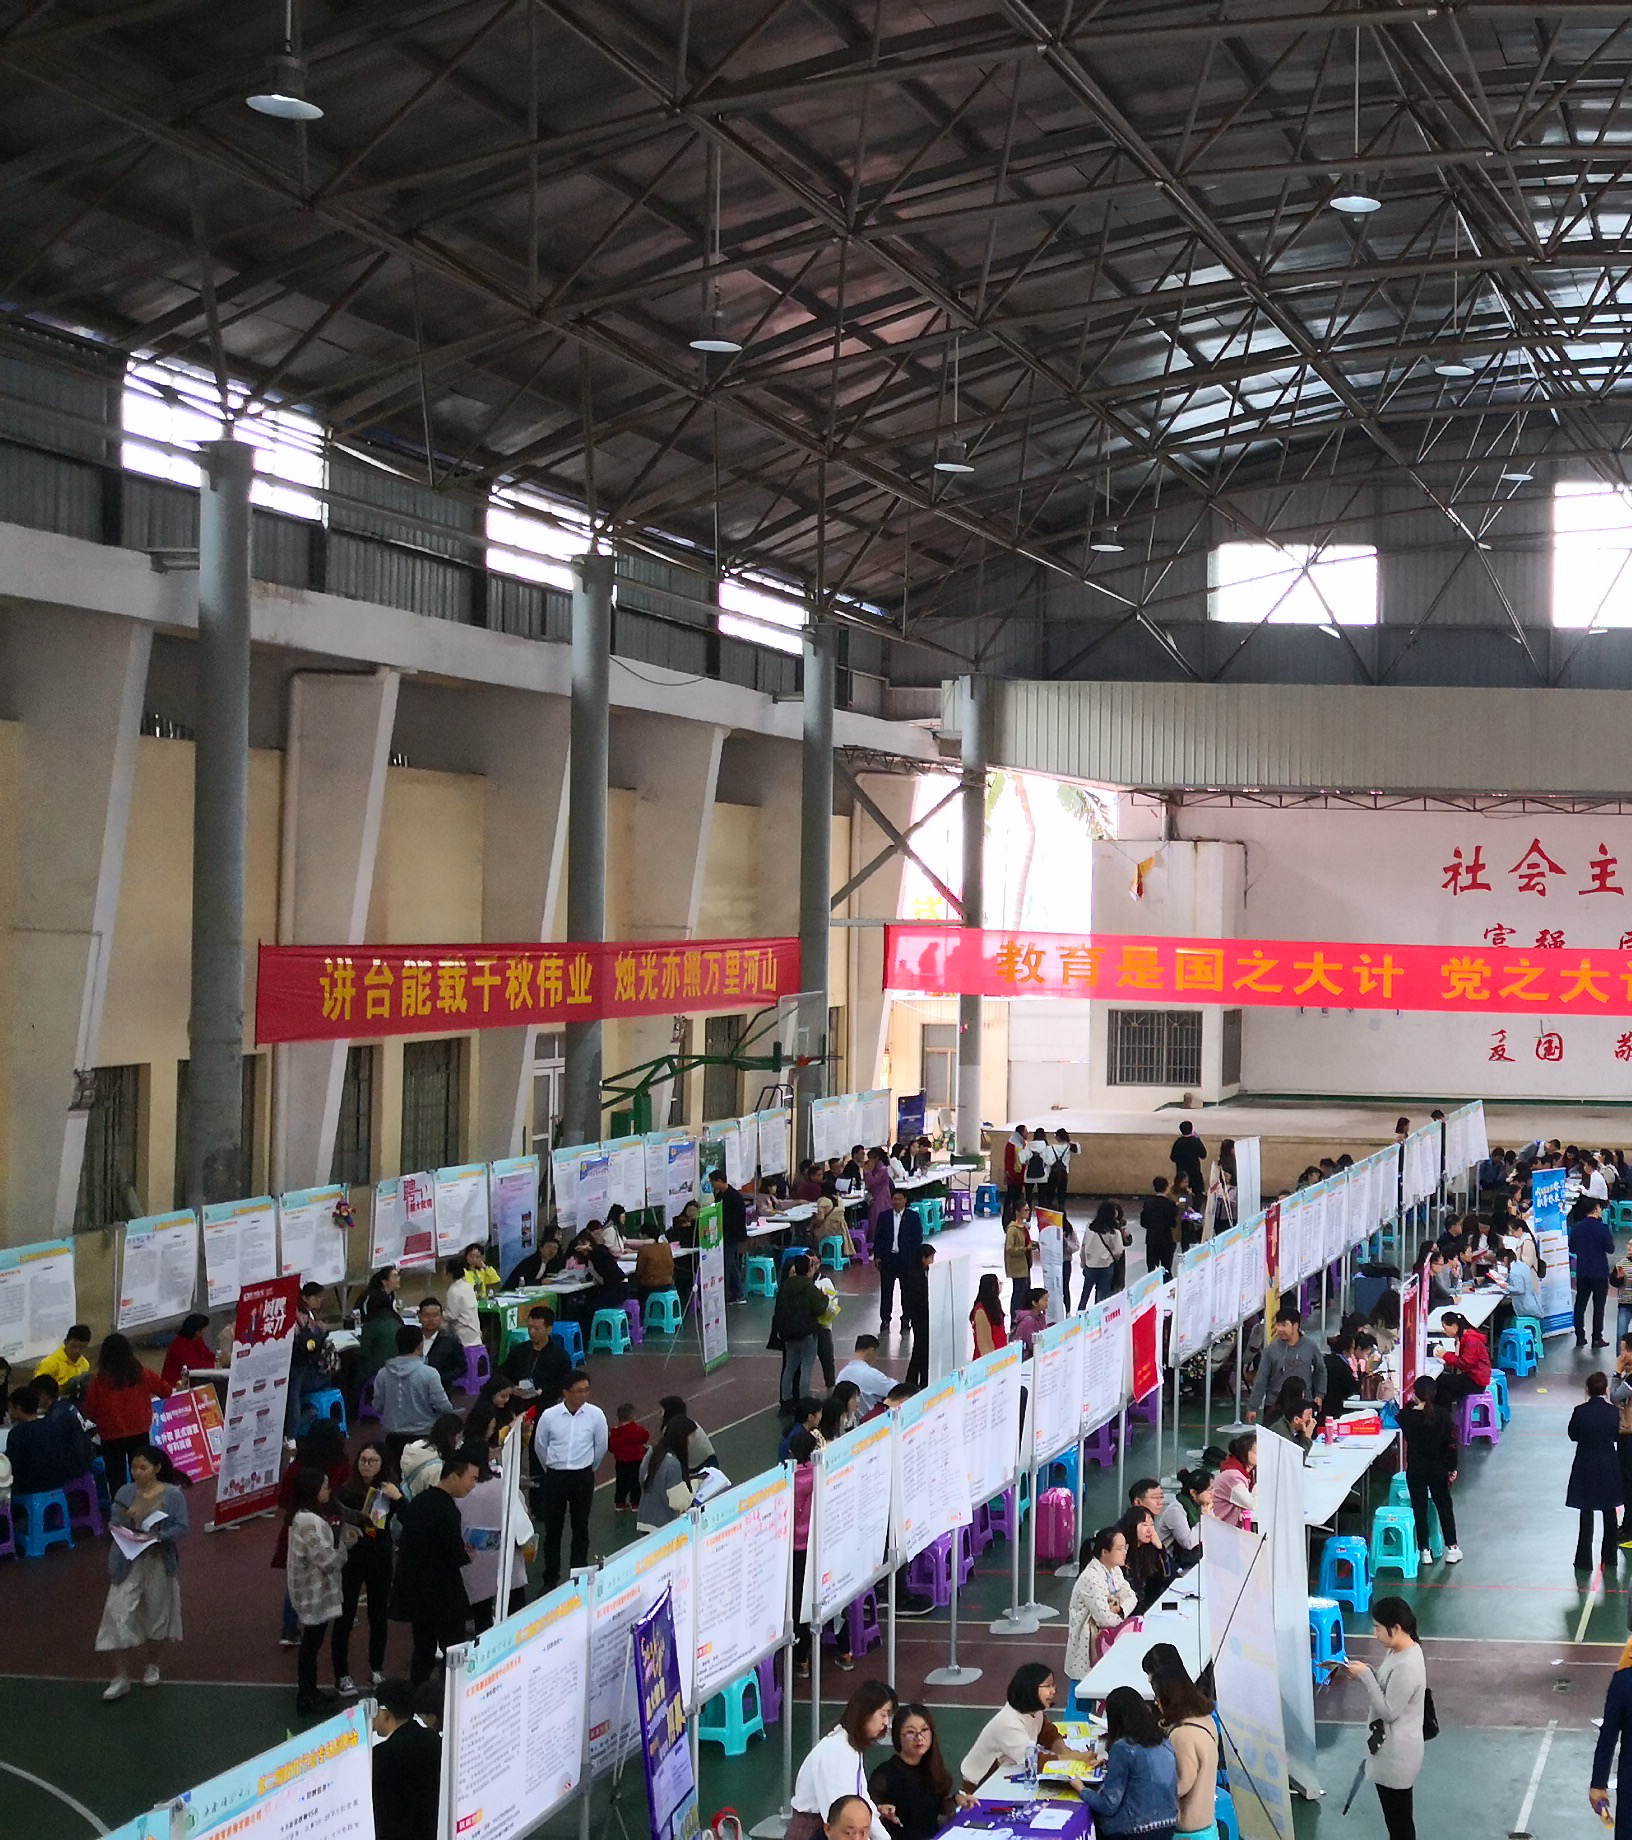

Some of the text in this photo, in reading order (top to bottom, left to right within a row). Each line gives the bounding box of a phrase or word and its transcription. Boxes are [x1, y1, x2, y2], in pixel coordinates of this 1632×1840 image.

[319, 947, 778, 1021] 讲台能载千秋伟业 烛光亦照万里河山
[995, 940, 1405, 999] 教育是国之大计
